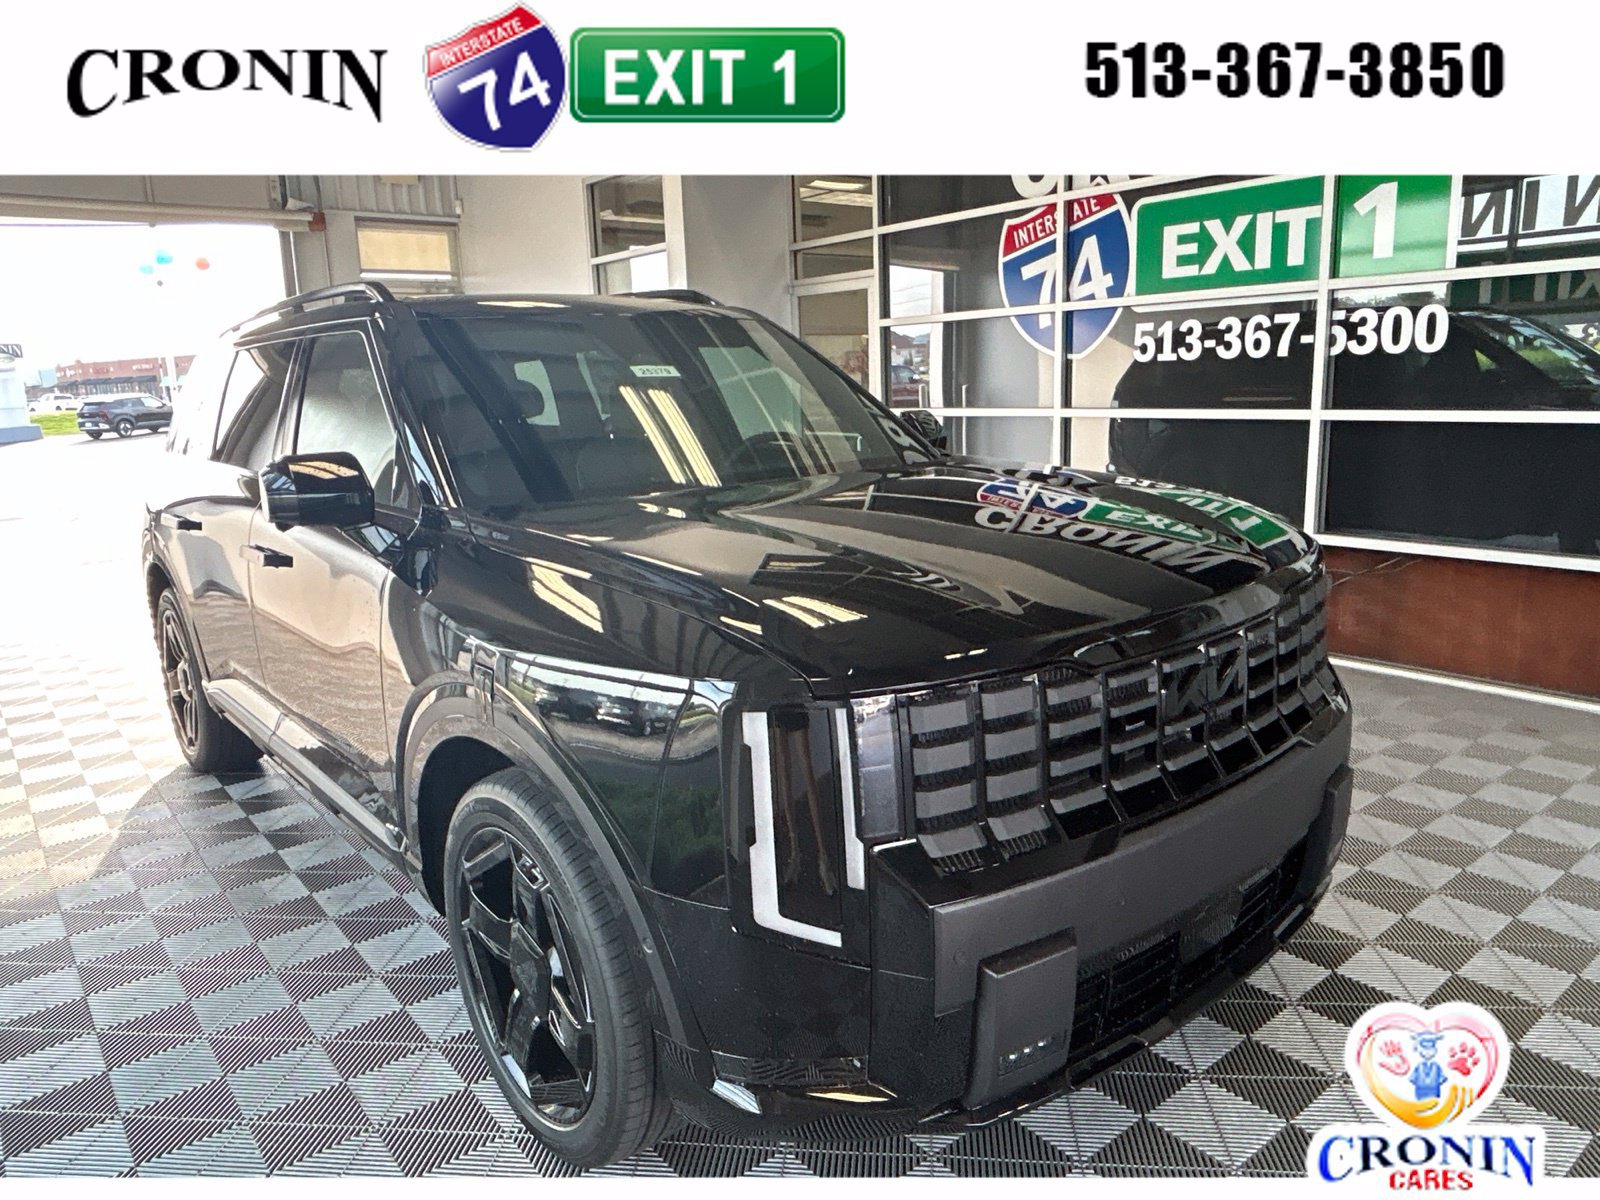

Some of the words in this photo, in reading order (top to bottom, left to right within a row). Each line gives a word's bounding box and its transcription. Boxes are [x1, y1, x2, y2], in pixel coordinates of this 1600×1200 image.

[1013, 197, 1101, 249] INTERATE
[1161, 205, 1319, 280] EXIT
[1353, 181, 1398, 260] 1
[1020, 234, 1114, 330] 74
[1133, 304, 1449, 363] 513-367-5300
